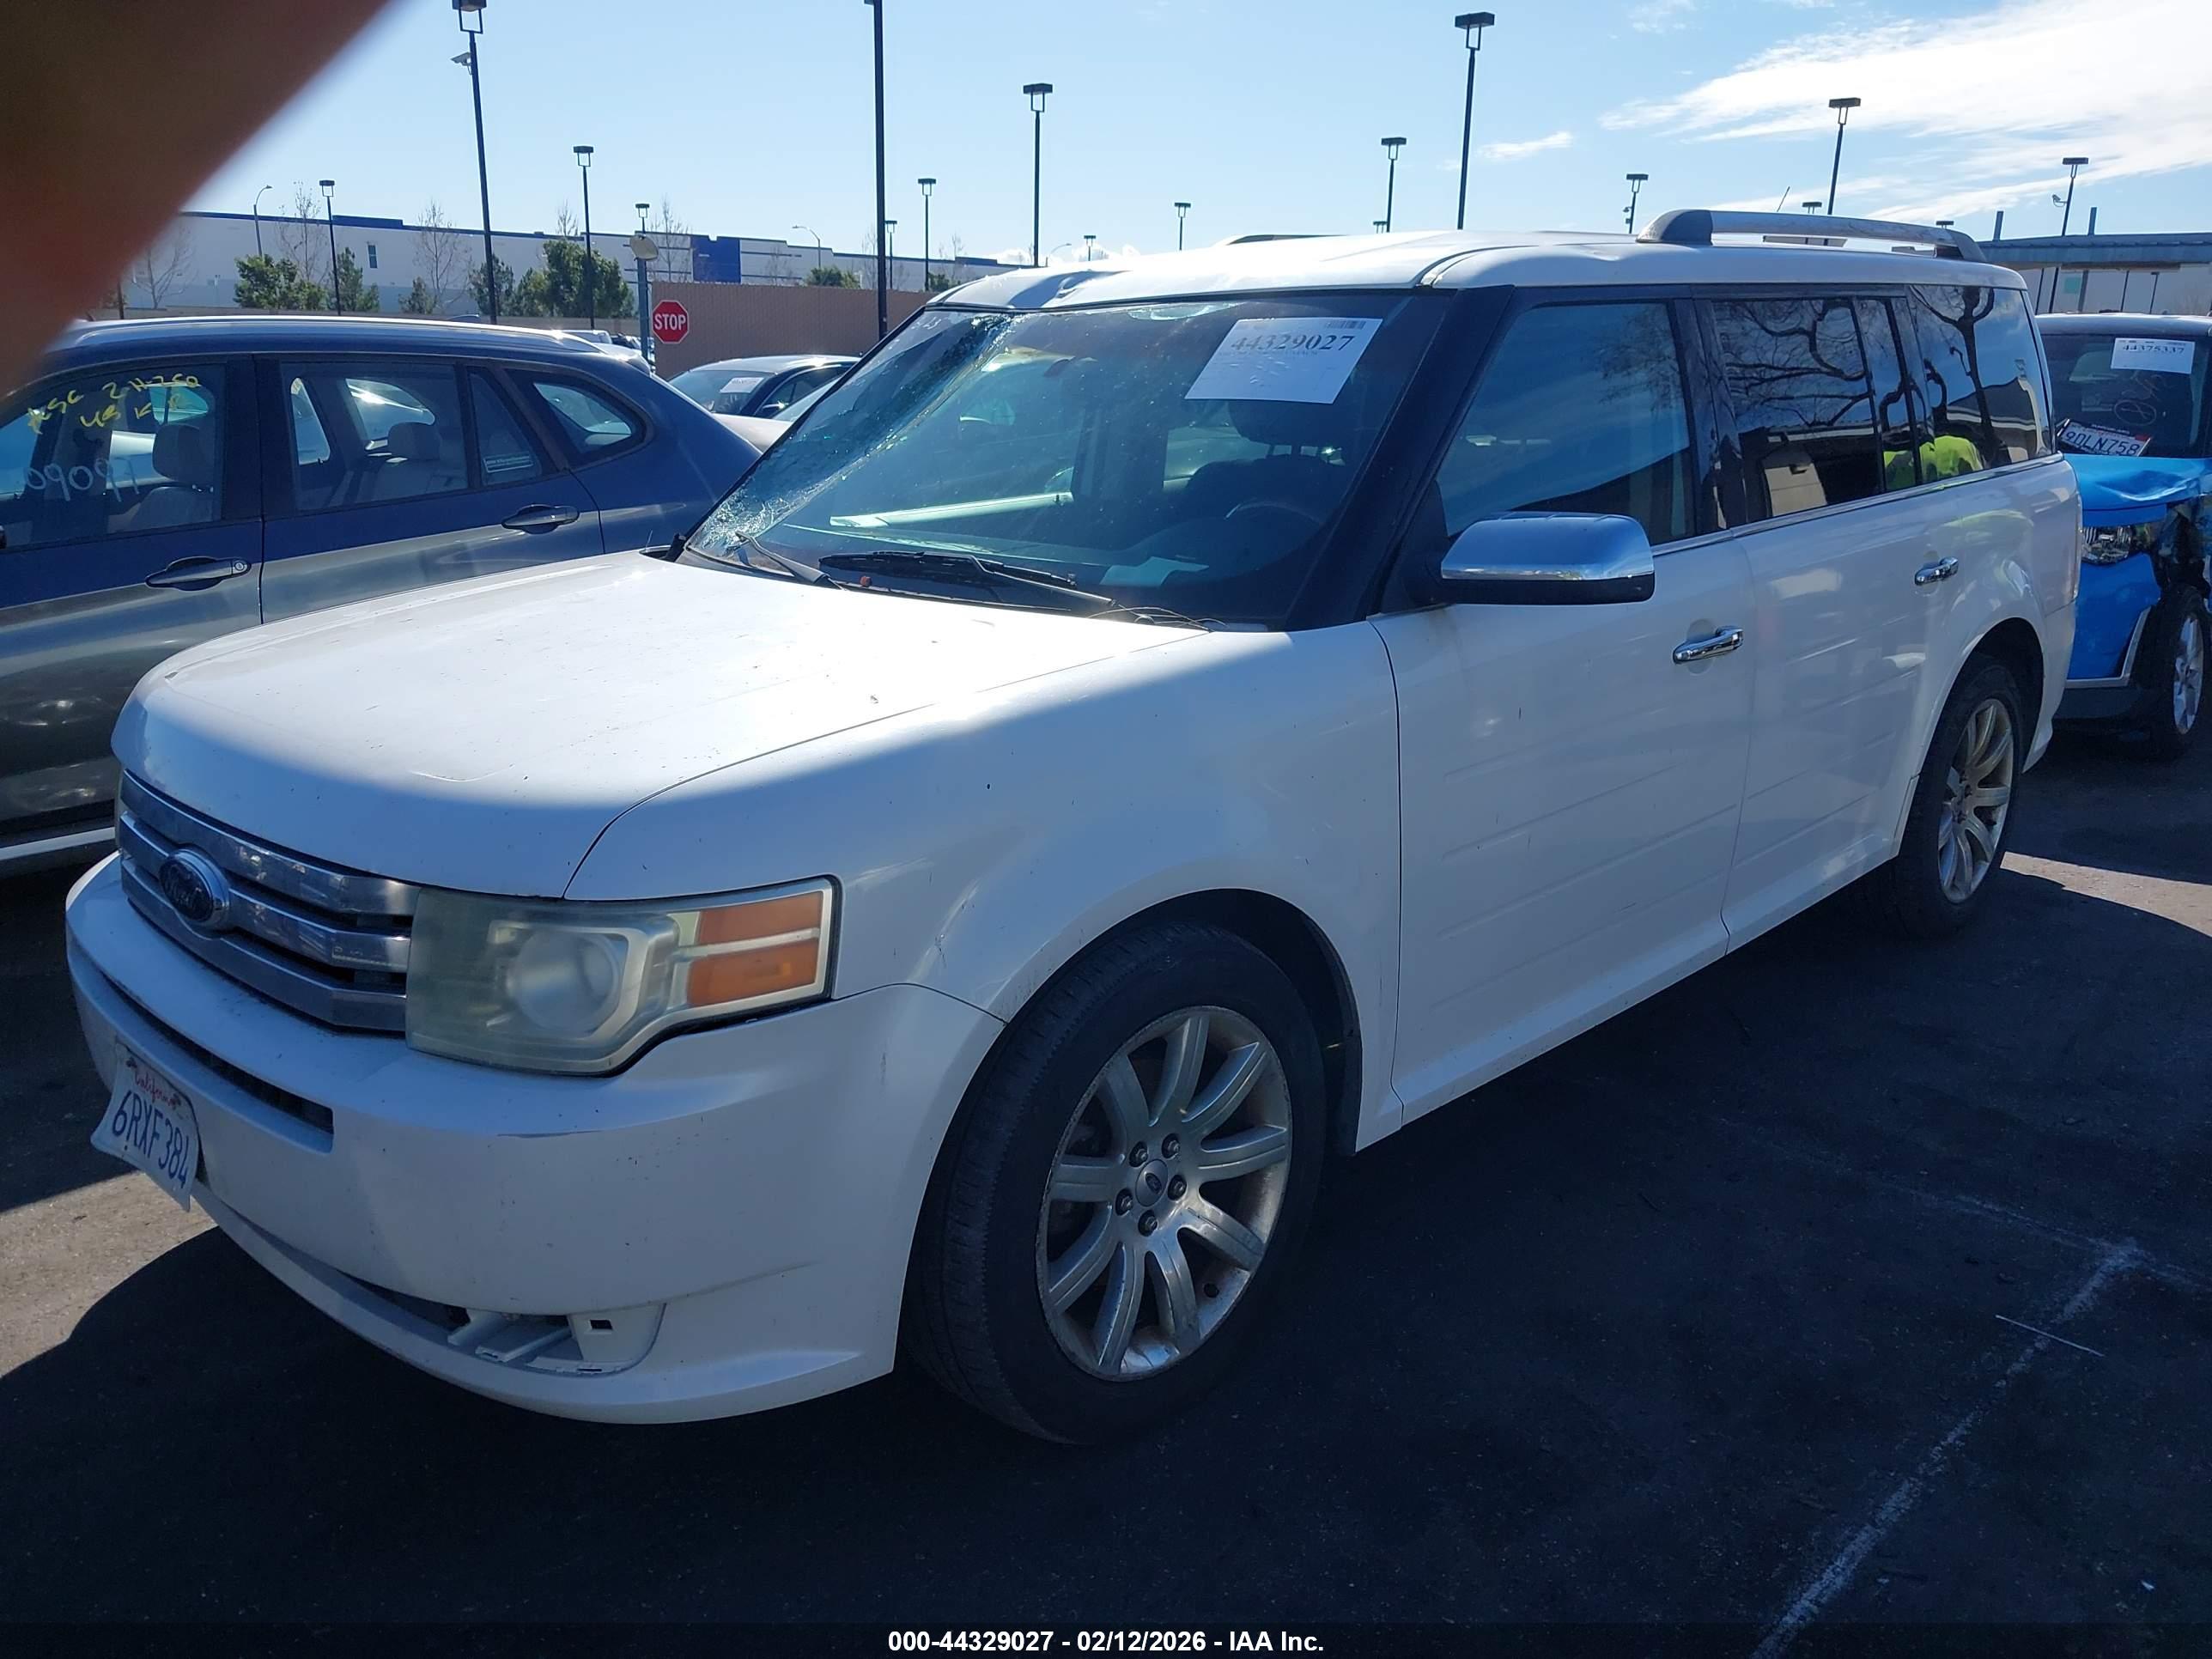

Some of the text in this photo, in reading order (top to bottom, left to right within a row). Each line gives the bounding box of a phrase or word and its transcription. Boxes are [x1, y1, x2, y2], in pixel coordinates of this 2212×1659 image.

[654, 313, 686, 331] STOP
[1230, 333, 1356, 352] 44329027
[2065, 430, 2141, 456] 9DLN758
[112, 1090, 189, 1189] 6RXF384
